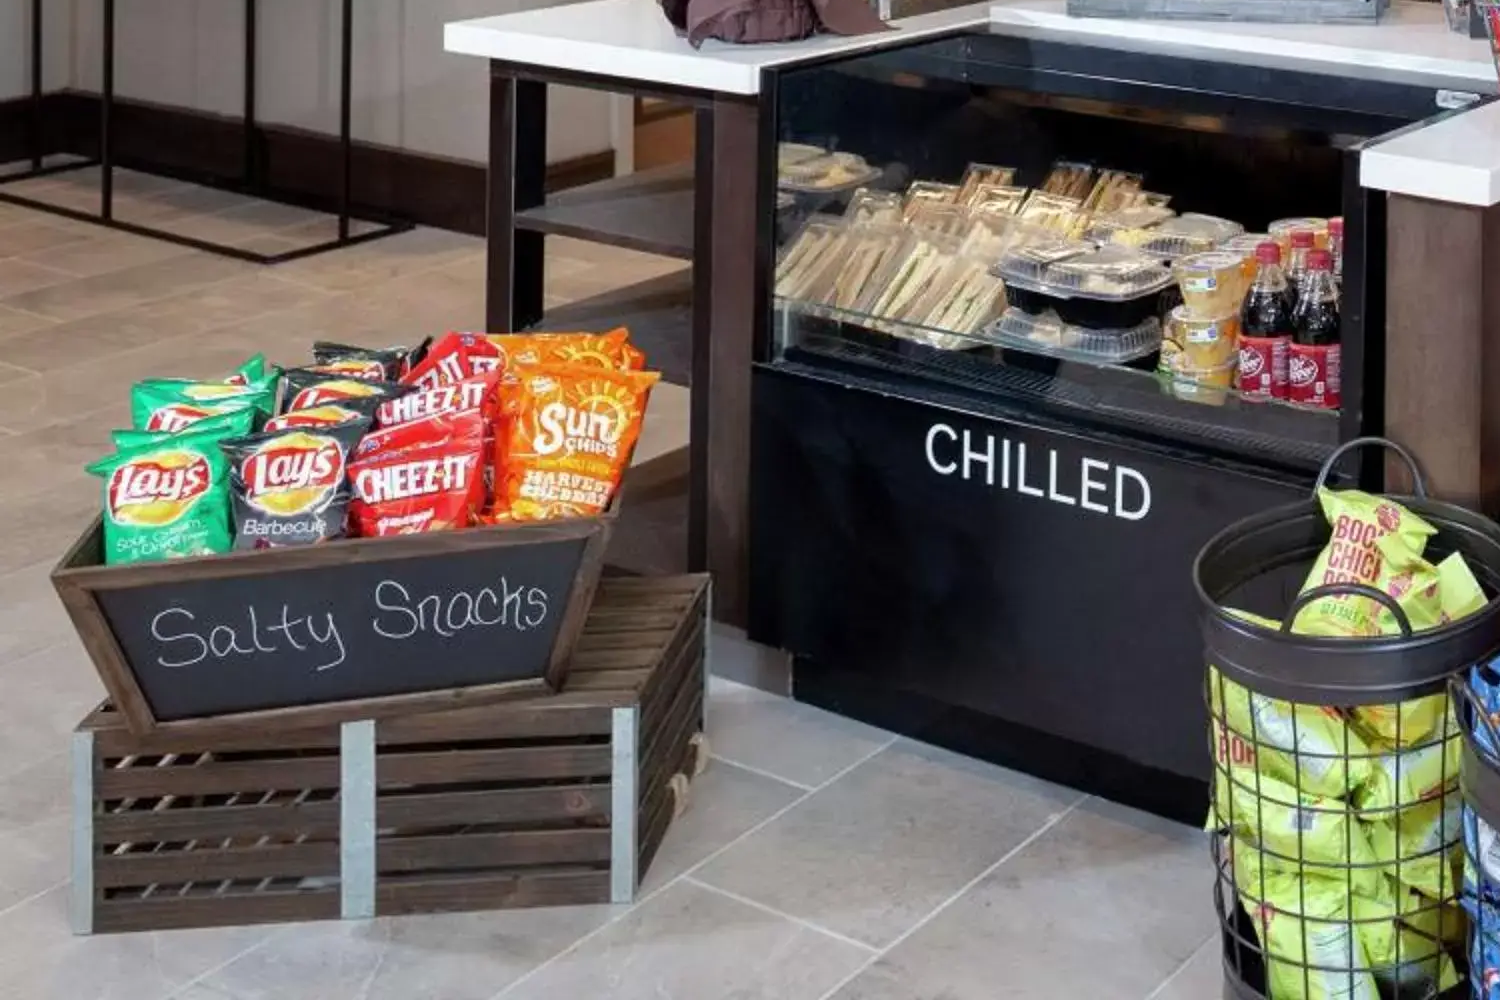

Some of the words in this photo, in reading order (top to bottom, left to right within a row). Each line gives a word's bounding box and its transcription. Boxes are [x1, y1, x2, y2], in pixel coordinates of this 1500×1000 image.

[533, 400, 620, 455] Sun
[924, 423, 1152, 522] CHILLED
[243, 519, 327, 536] Barbecue
[150, 603, 346, 672] Salty
[372, 576, 549, 640] Snacks
